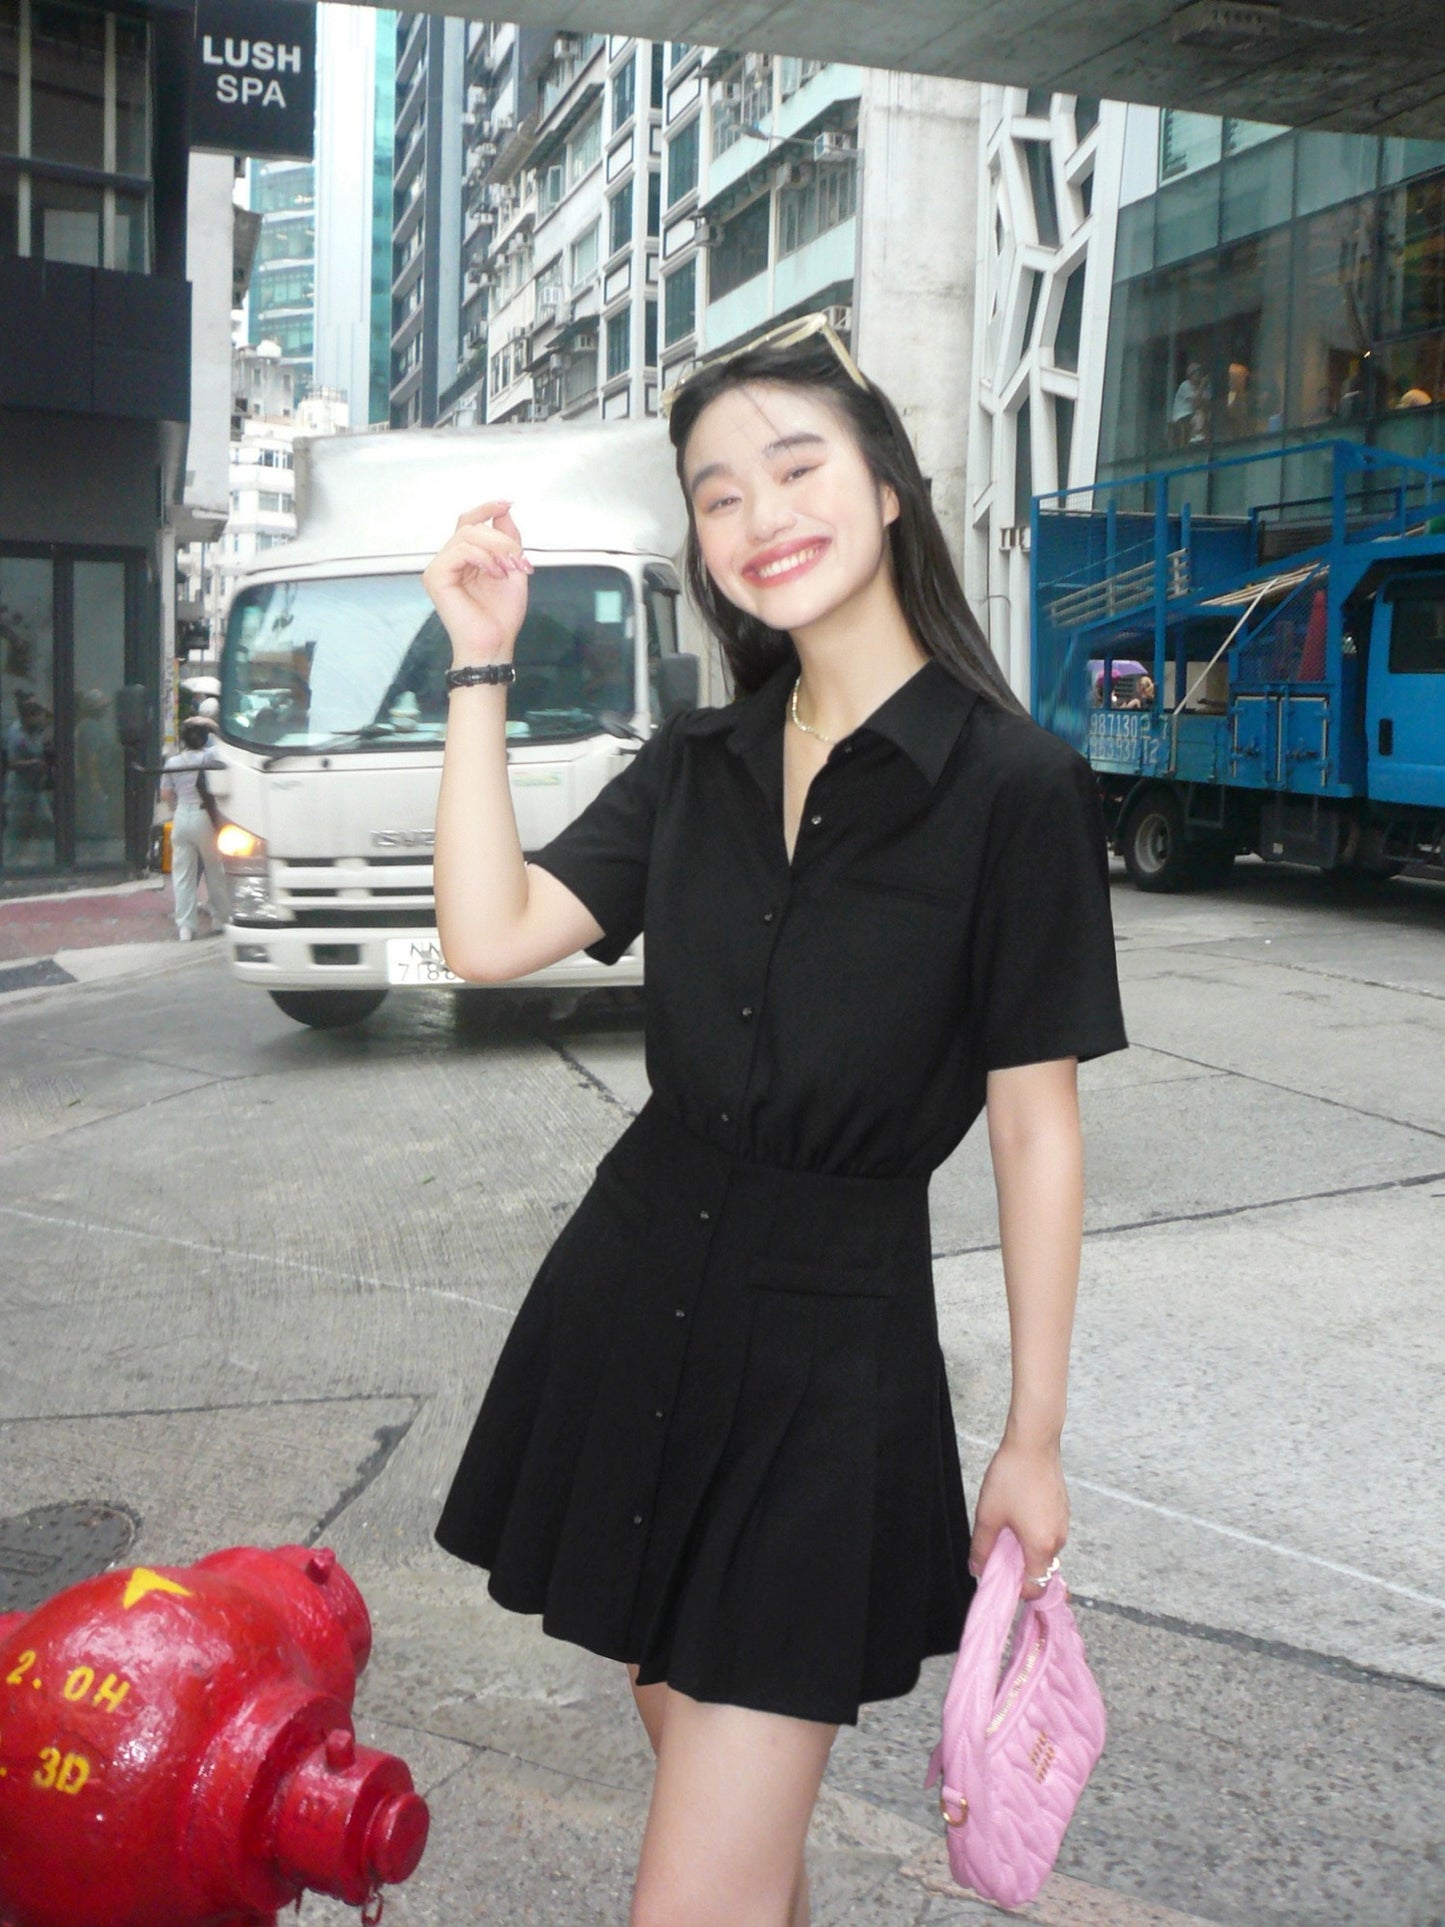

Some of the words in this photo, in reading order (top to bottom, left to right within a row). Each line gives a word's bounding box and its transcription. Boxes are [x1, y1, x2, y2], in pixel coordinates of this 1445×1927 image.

[203, 35, 301, 74] LUSH
[216, 73, 286, 109] SPA
[370, 829, 437, 848] ISUZ
